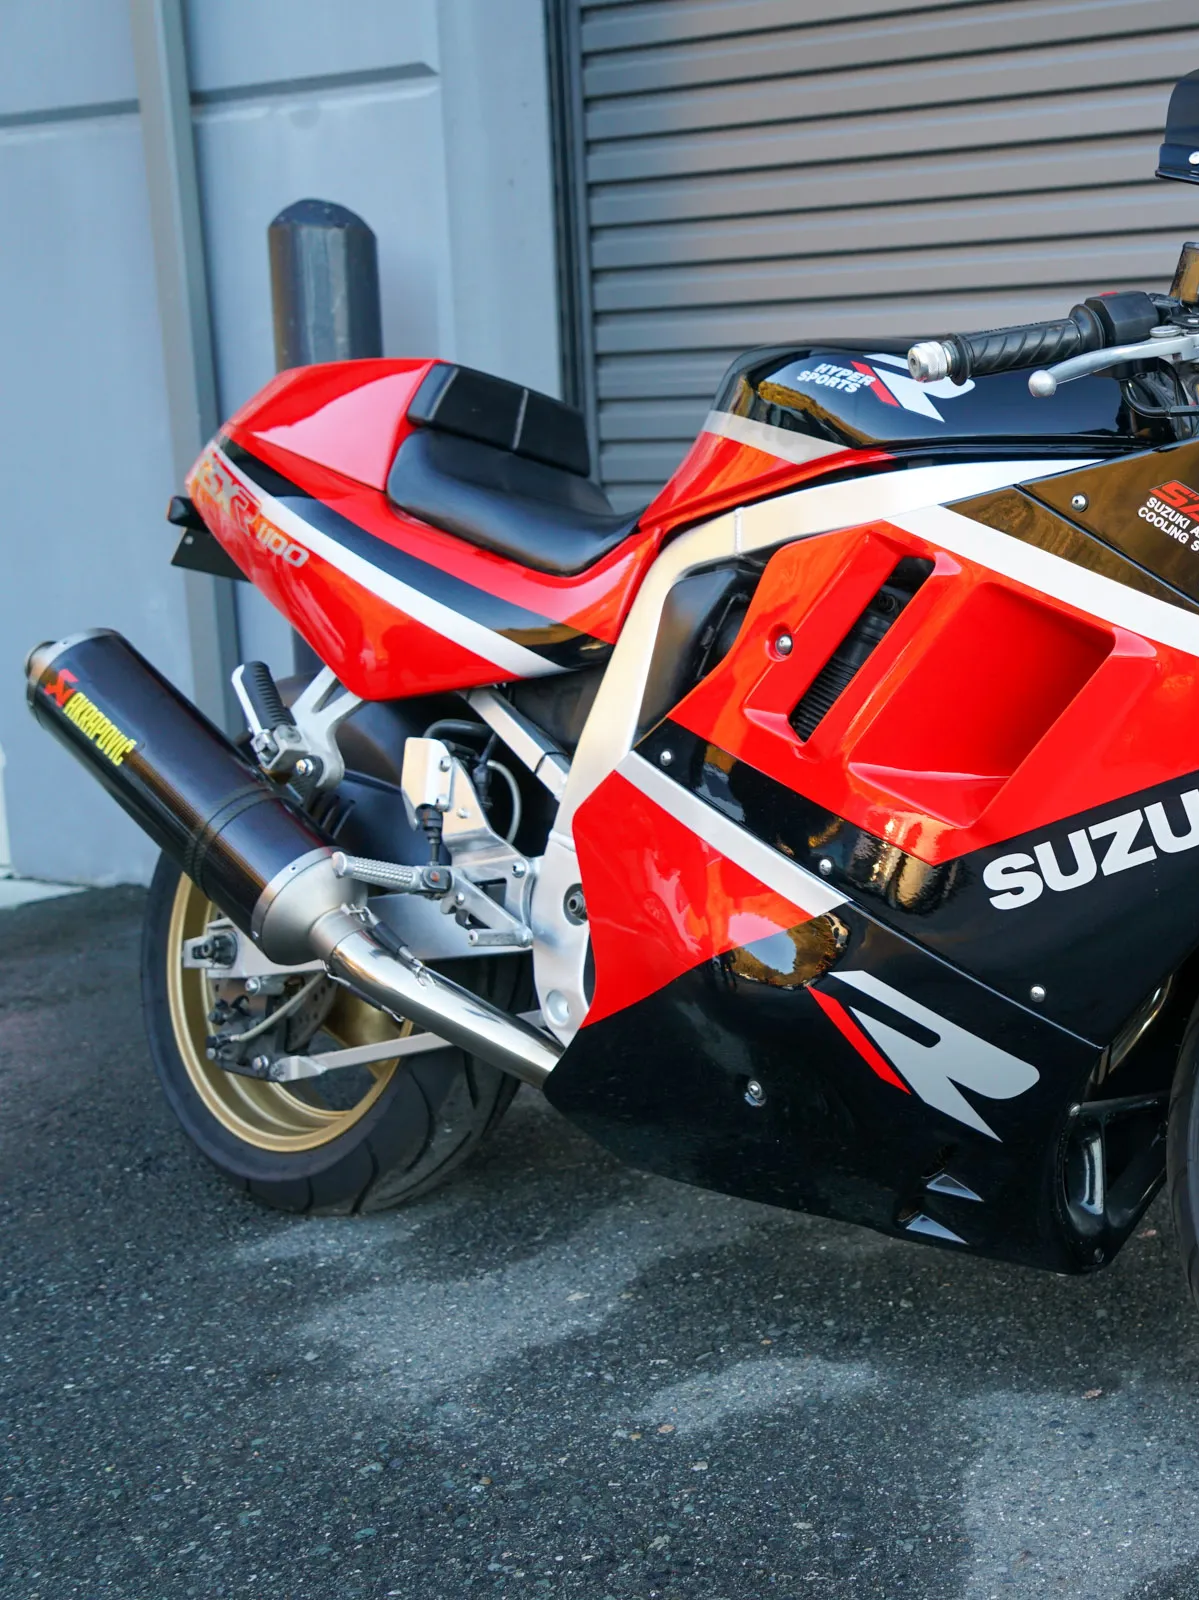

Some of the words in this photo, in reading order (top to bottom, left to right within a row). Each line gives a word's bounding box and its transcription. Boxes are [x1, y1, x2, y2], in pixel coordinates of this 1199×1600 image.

[797, 370, 861, 393] SPORTS
[813, 362, 877, 386] HYPER
[1137, 507, 1190, 545] COOLING
[1146, 496, 1191, 530] SUZUKI
[256, 522, 310, 568] 1100
[806, 970, 1040, 1143] R
